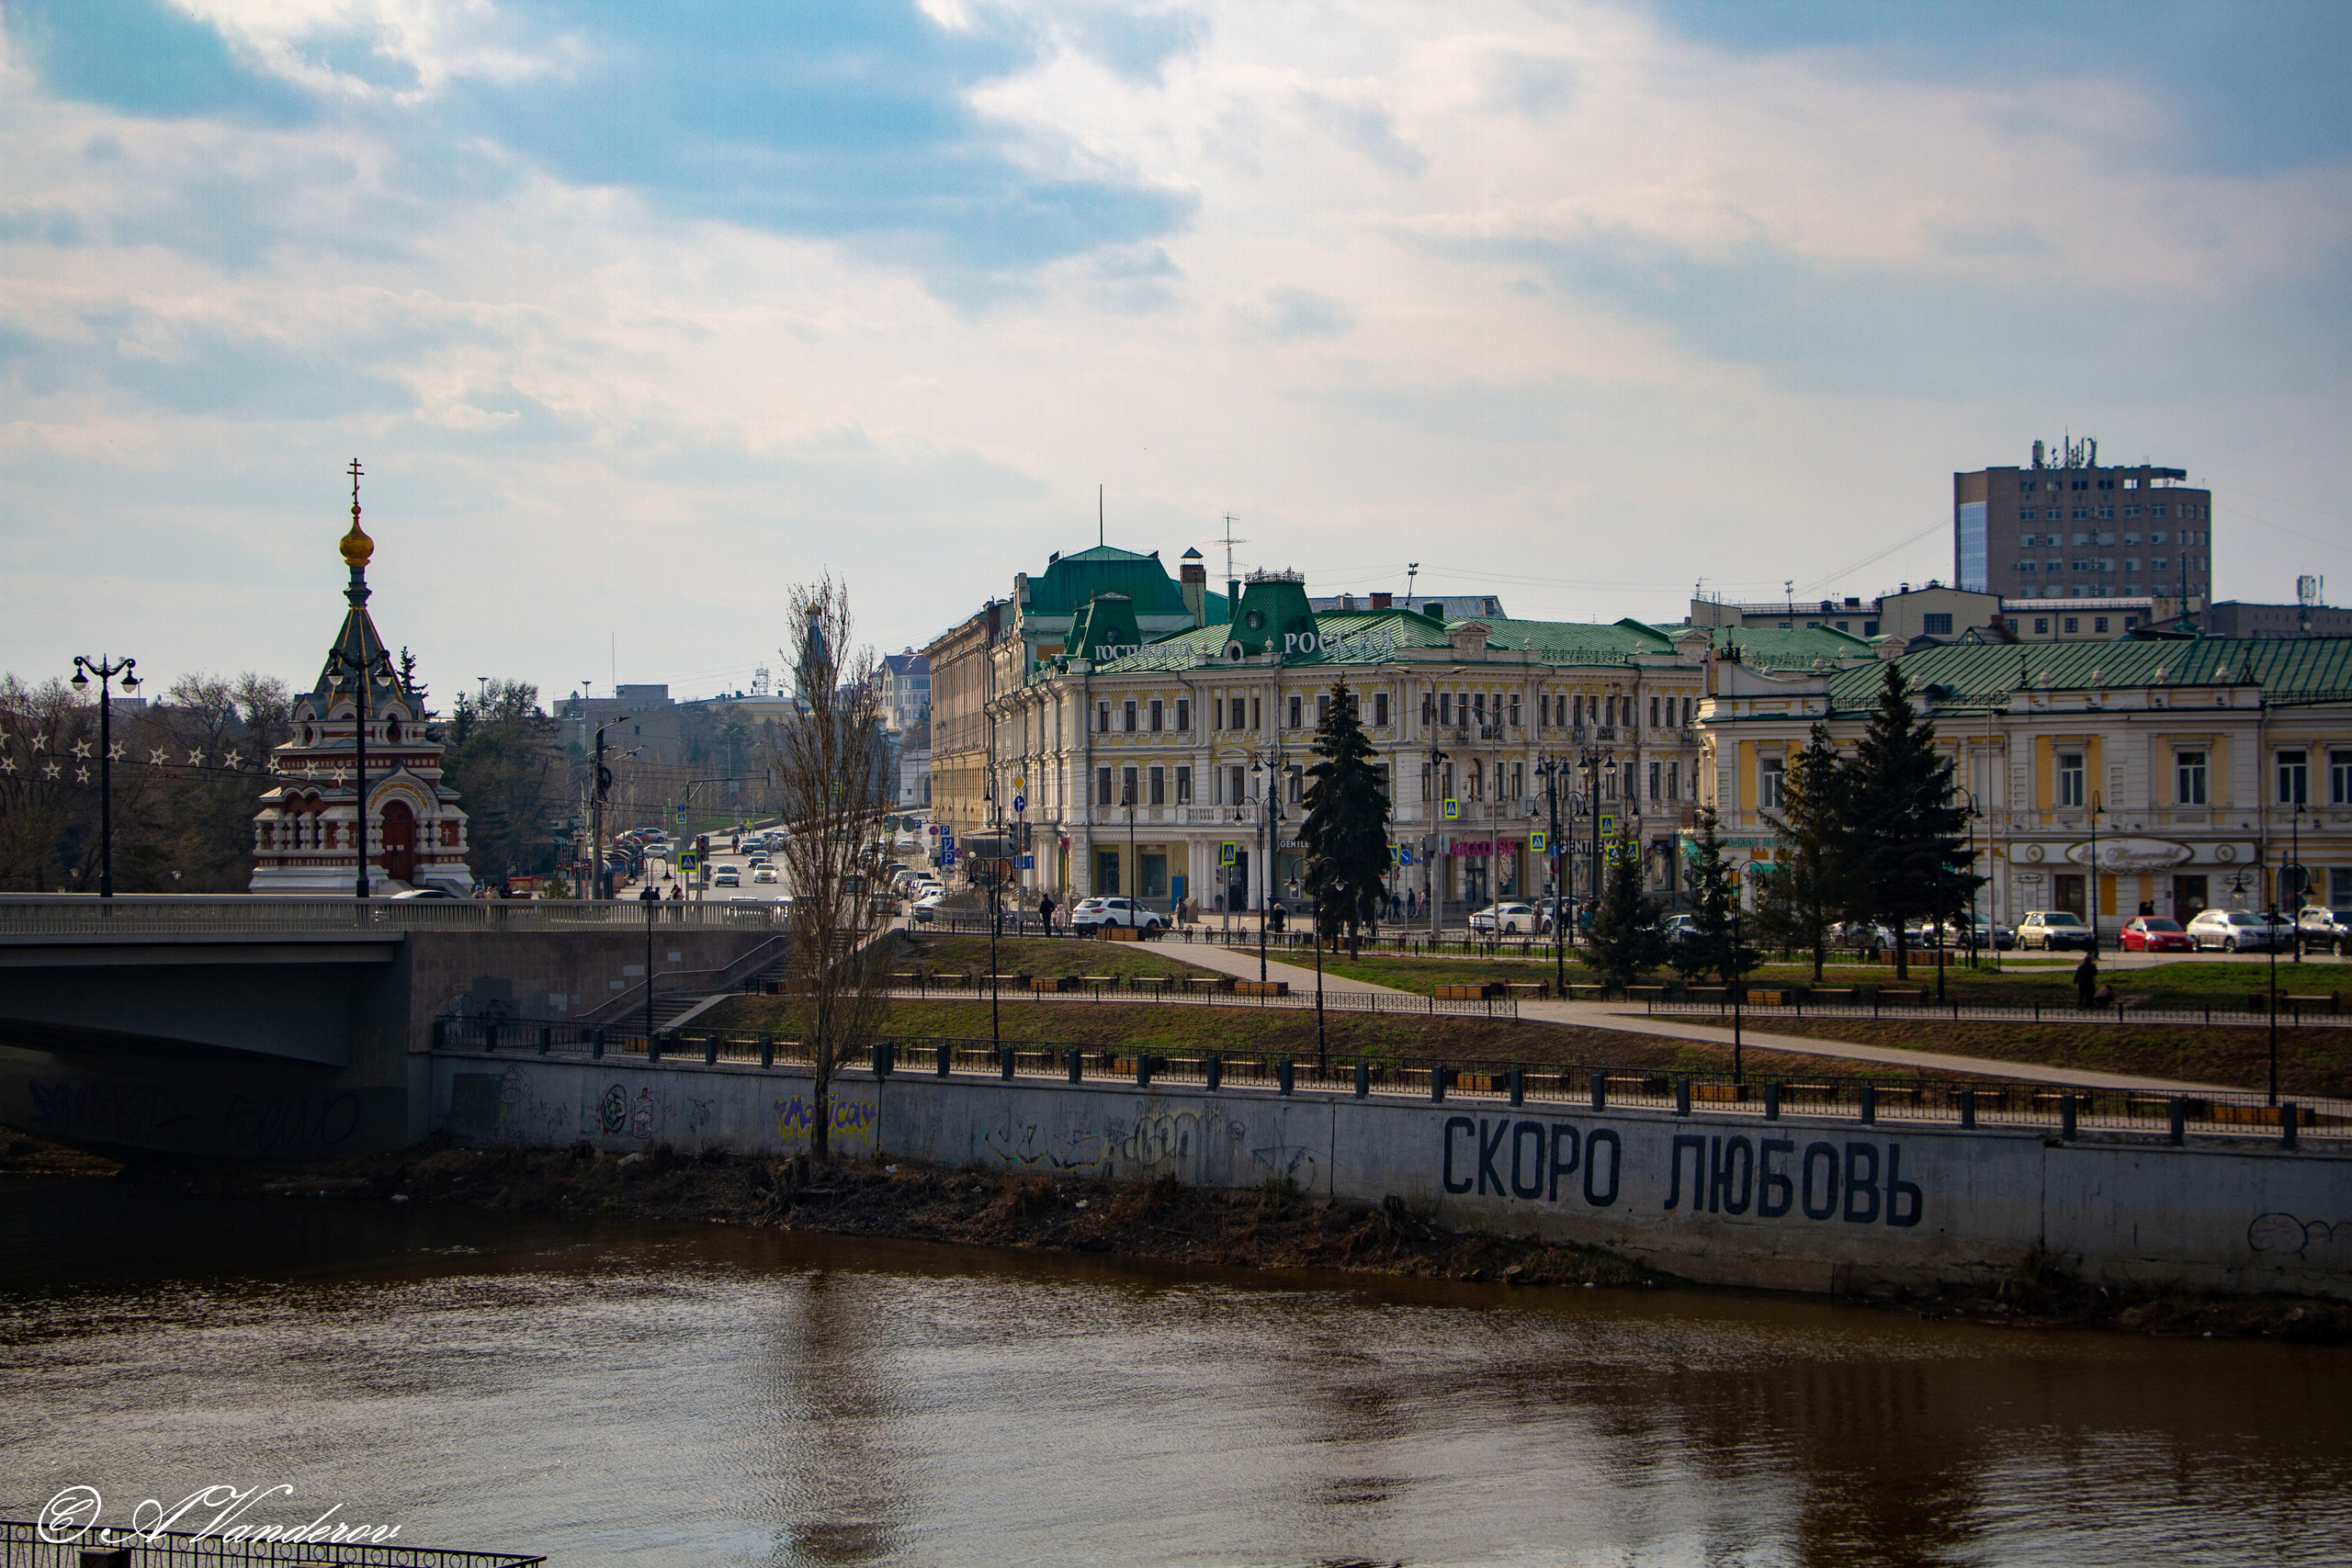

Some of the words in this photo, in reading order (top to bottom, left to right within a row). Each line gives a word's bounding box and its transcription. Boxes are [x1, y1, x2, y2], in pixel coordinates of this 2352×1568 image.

[1094, 642, 1193, 660] ГОСТИНИЦА
[1283, 629, 1391, 654] РОССИЯ
[1442, 839, 1517, 857] ARADSE
[901, 872, 917, 880] СТОП
[1442, 1116, 1622, 1207] СКОРО
[1663, 1134, 1923, 1227] ЛЮБОВЬ
